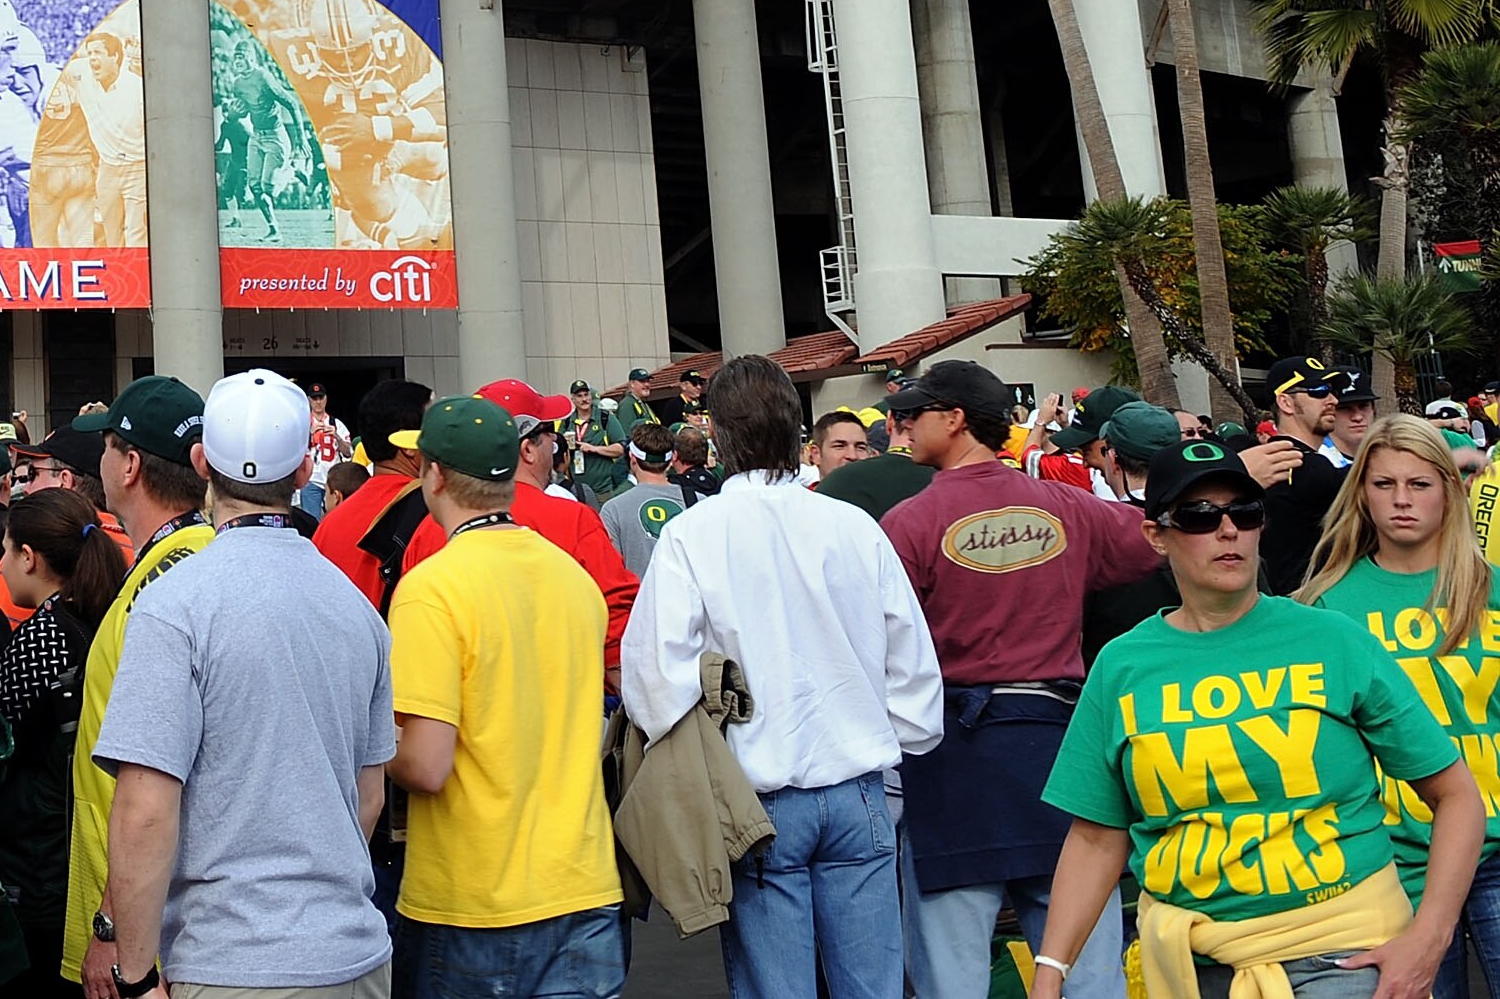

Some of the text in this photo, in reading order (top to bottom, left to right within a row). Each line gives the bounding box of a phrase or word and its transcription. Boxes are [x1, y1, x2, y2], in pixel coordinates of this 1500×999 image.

[238, 254, 431, 304] presented by citi
[262, 336, 279, 351] 26
[243, 461, 257, 479] O
[1118, 662, 1327, 737] I LOVE
[1129, 708, 1322, 817] MY
[1144, 802, 1346, 900] DUCKS
